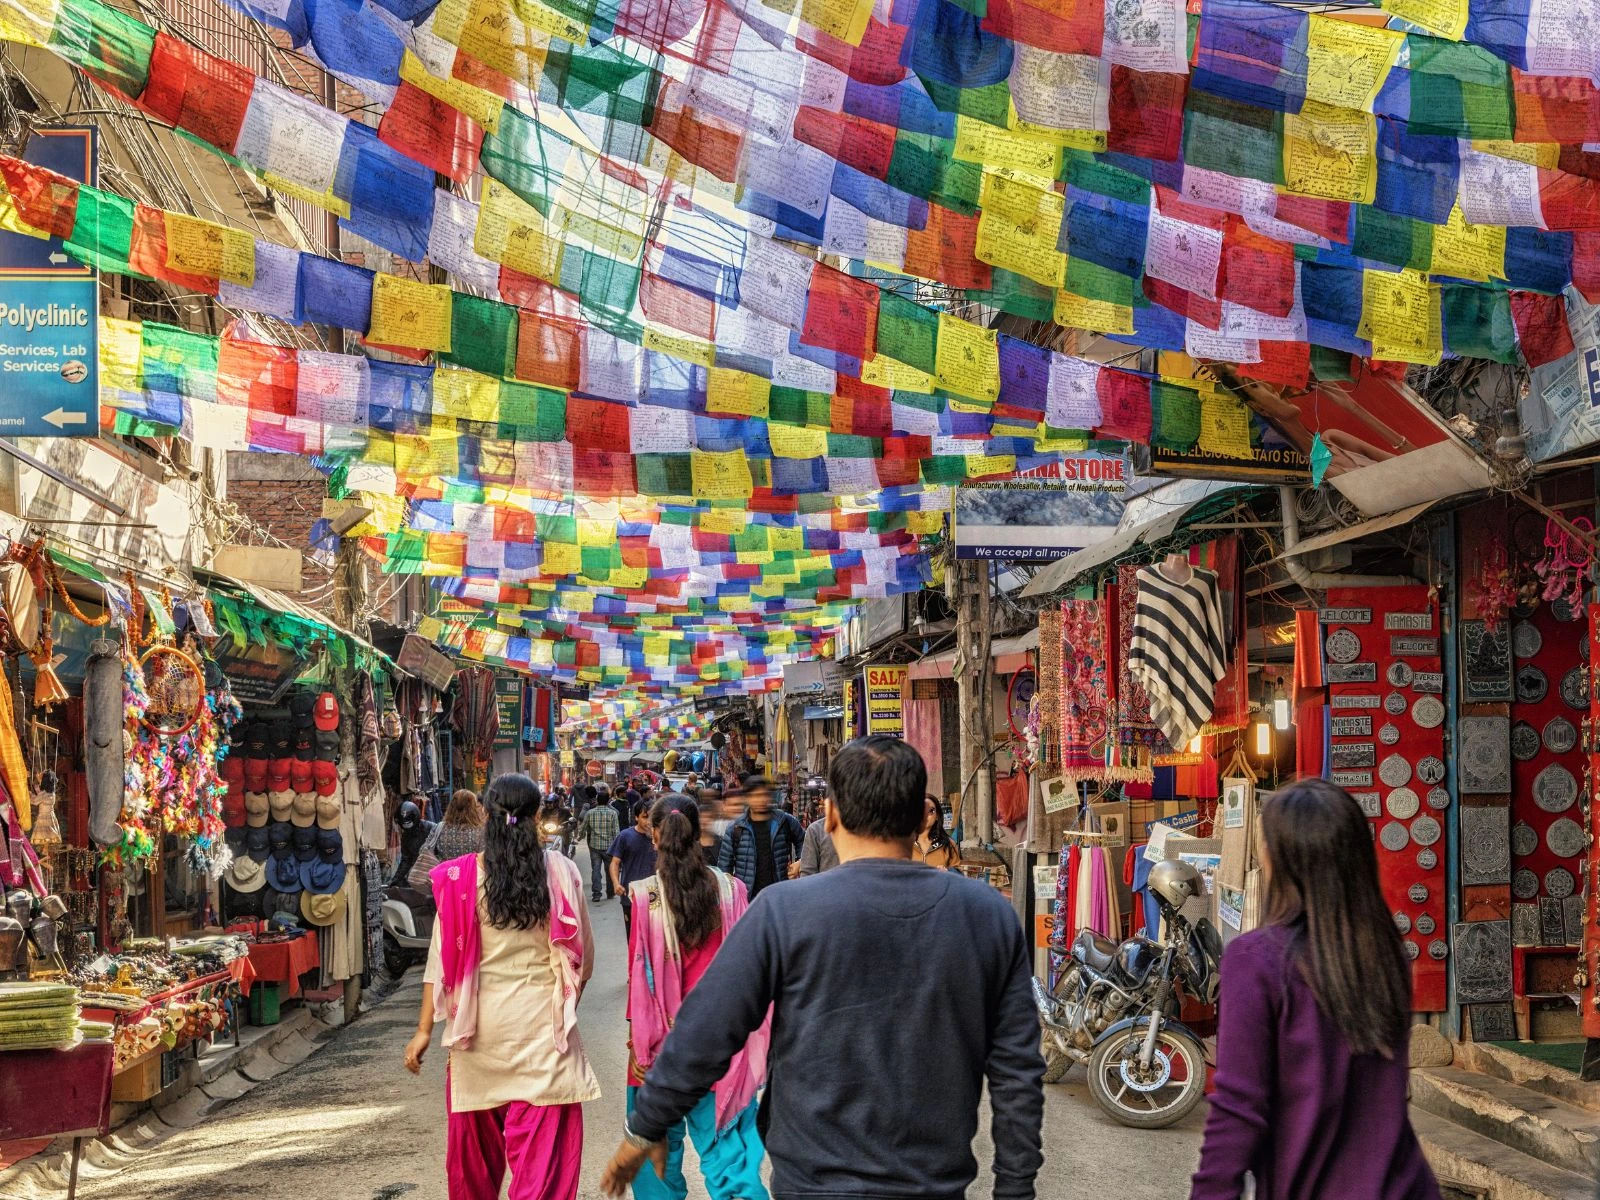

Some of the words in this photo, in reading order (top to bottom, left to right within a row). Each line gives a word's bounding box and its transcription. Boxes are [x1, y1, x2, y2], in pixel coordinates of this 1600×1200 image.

[63, 344, 87, 356] Lab
[4, 361, 60, 372] Services
[1064, 458, 1124, 481] STORE
[1077, 484, 1097, 493] Nepali
[1097, 485, 1125, 493] Products
[975, 547, 992, 556] We
[994, 549, 1033, 559] accept
[1035, 549, 1048, 558] all
[1319, 610, 1370, 621] WELCOME
[1385, 615, 1431, 629] NAMASTE
[1396, 643, 1434, 651] WELCOME
[1414, 673, 1442, 681] EVEREST
[1332, 718, 1371, 727] NAMASTE
[1338, 726, 1365, 735] NEPAL
[1332, 744, 1374, 752] NAMASTE
